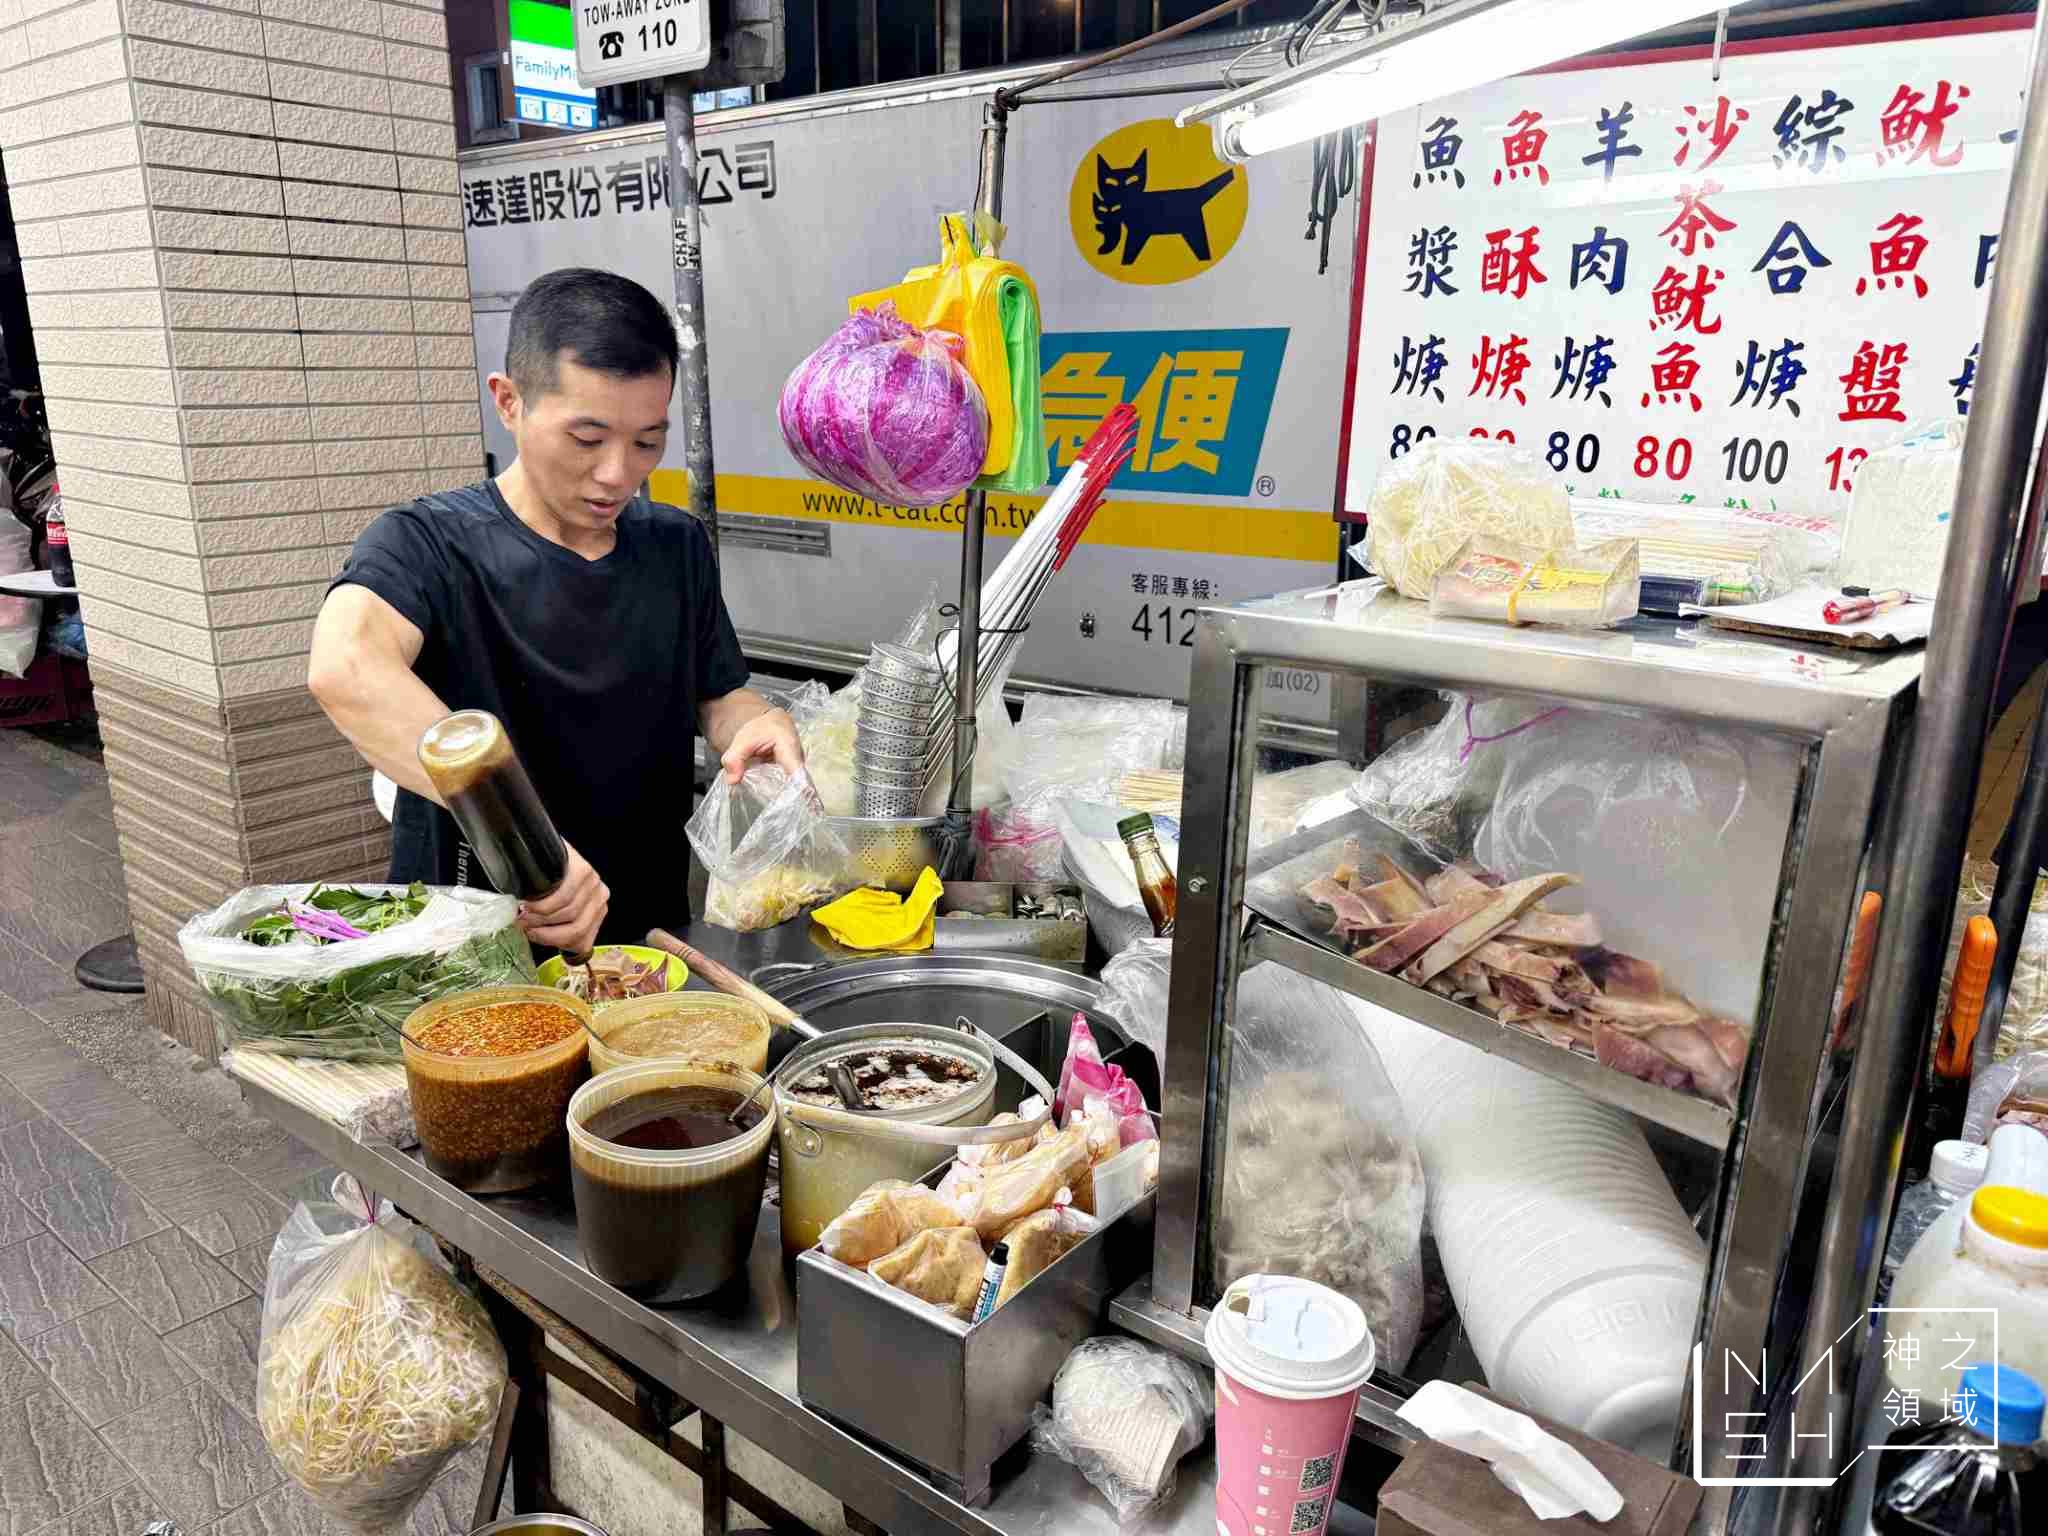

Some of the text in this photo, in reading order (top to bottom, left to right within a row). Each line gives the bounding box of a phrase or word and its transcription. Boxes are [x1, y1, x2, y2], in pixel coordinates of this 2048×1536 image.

[638, 19, 677, 51] 110
[515, 55, 577, 80] FamilyM
[1040, 350, 1244, 475] 急便
[1546, 431, 1600, 473] 80
[1634, 436, 1692, 480] 80
[1721, 437, 1788, 483] 100
[1131, 573, 1220, 600] 客服專線:
